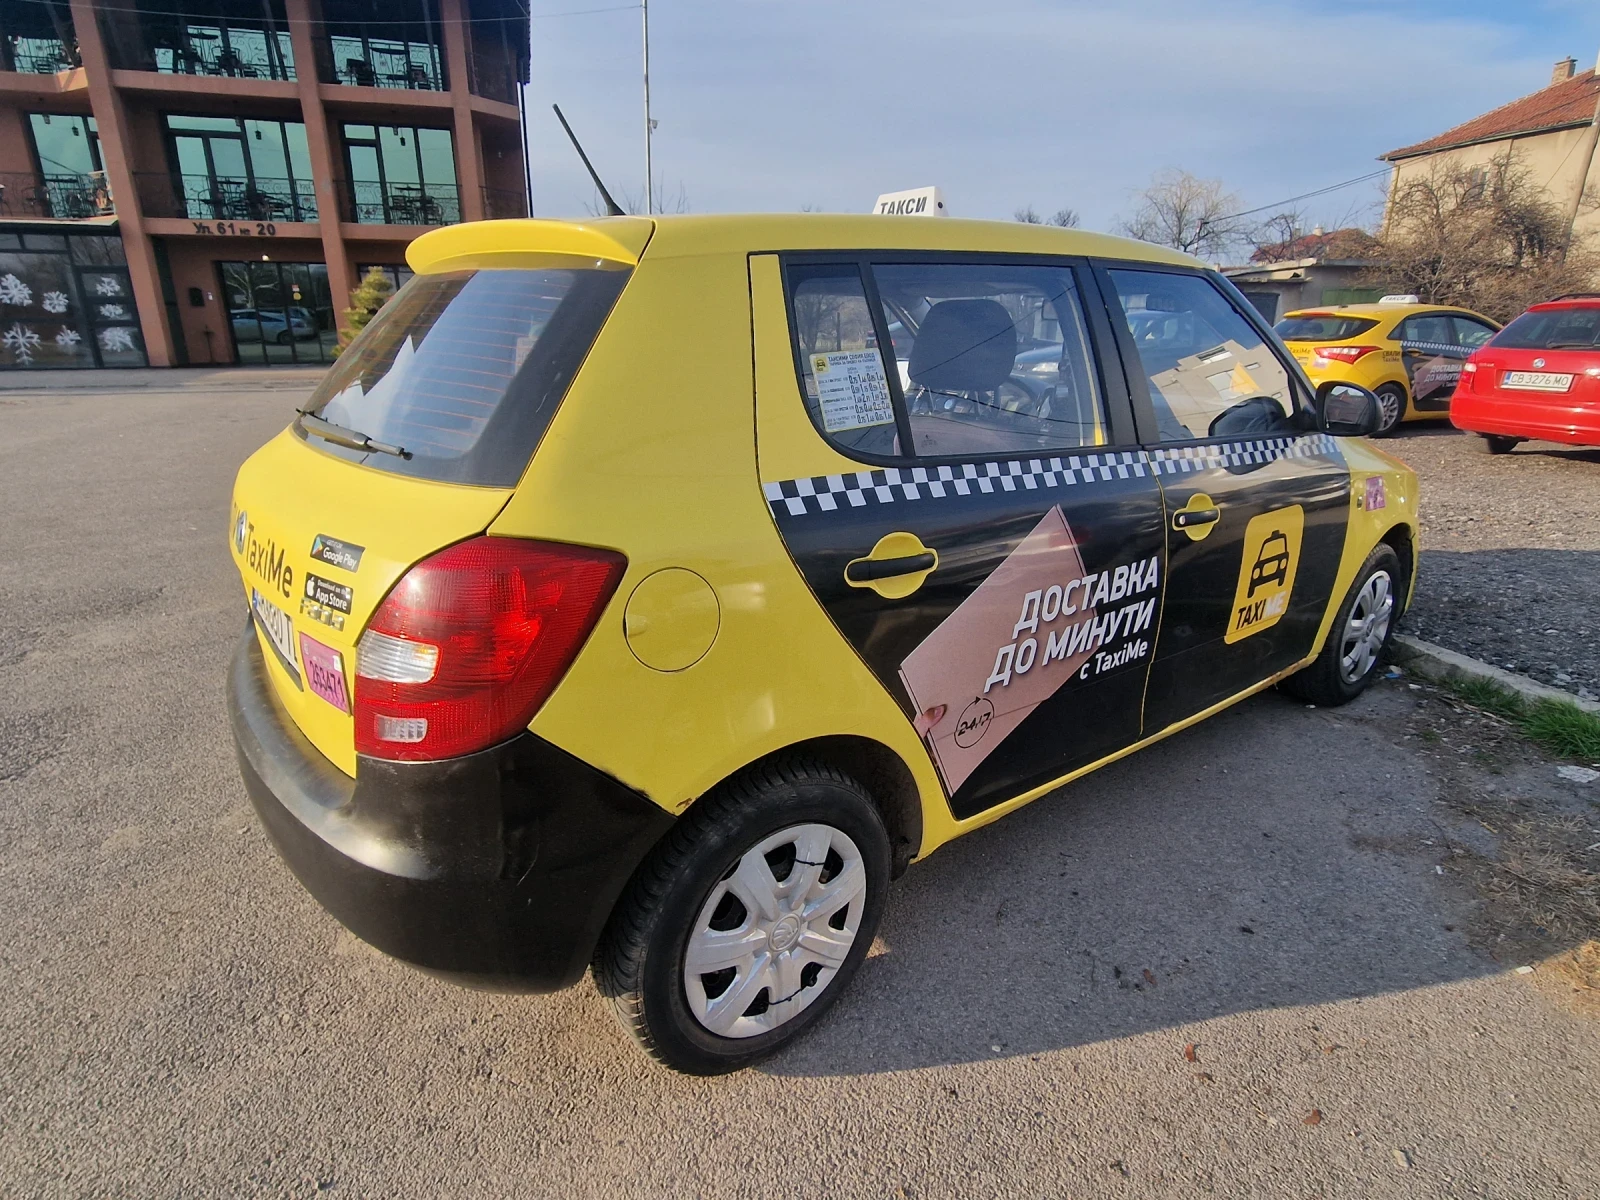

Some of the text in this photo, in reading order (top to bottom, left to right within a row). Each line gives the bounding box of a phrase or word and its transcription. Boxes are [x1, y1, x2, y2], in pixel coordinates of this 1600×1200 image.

[880, 196, 928, 215] ТАКСИ
[217, 222, 235, 234] 61
[256, 223, 276, 236] 20
[1424, 374, 1435, 383] ДО
[1430, 364, 1463, 373] ДОСТАВКА
[1525, 374, 1551, 385] 3276
[1552, 376, 1570, 386] MO
[245, 522, 292, 598] TaxiMe
[323, 547, 358, 570] Google Play
[315, 588, 348, 610] App Store
[1011, 555, 1159, 640] ДОСТАВКА
[1236, 591, 1288, 630] TAXIME
[983, 597, 1156, 694] ДО МИНУТИ
[1094, 638, 1148, 674] TaxiMe
[957, 712, 992, 737] 24/7
